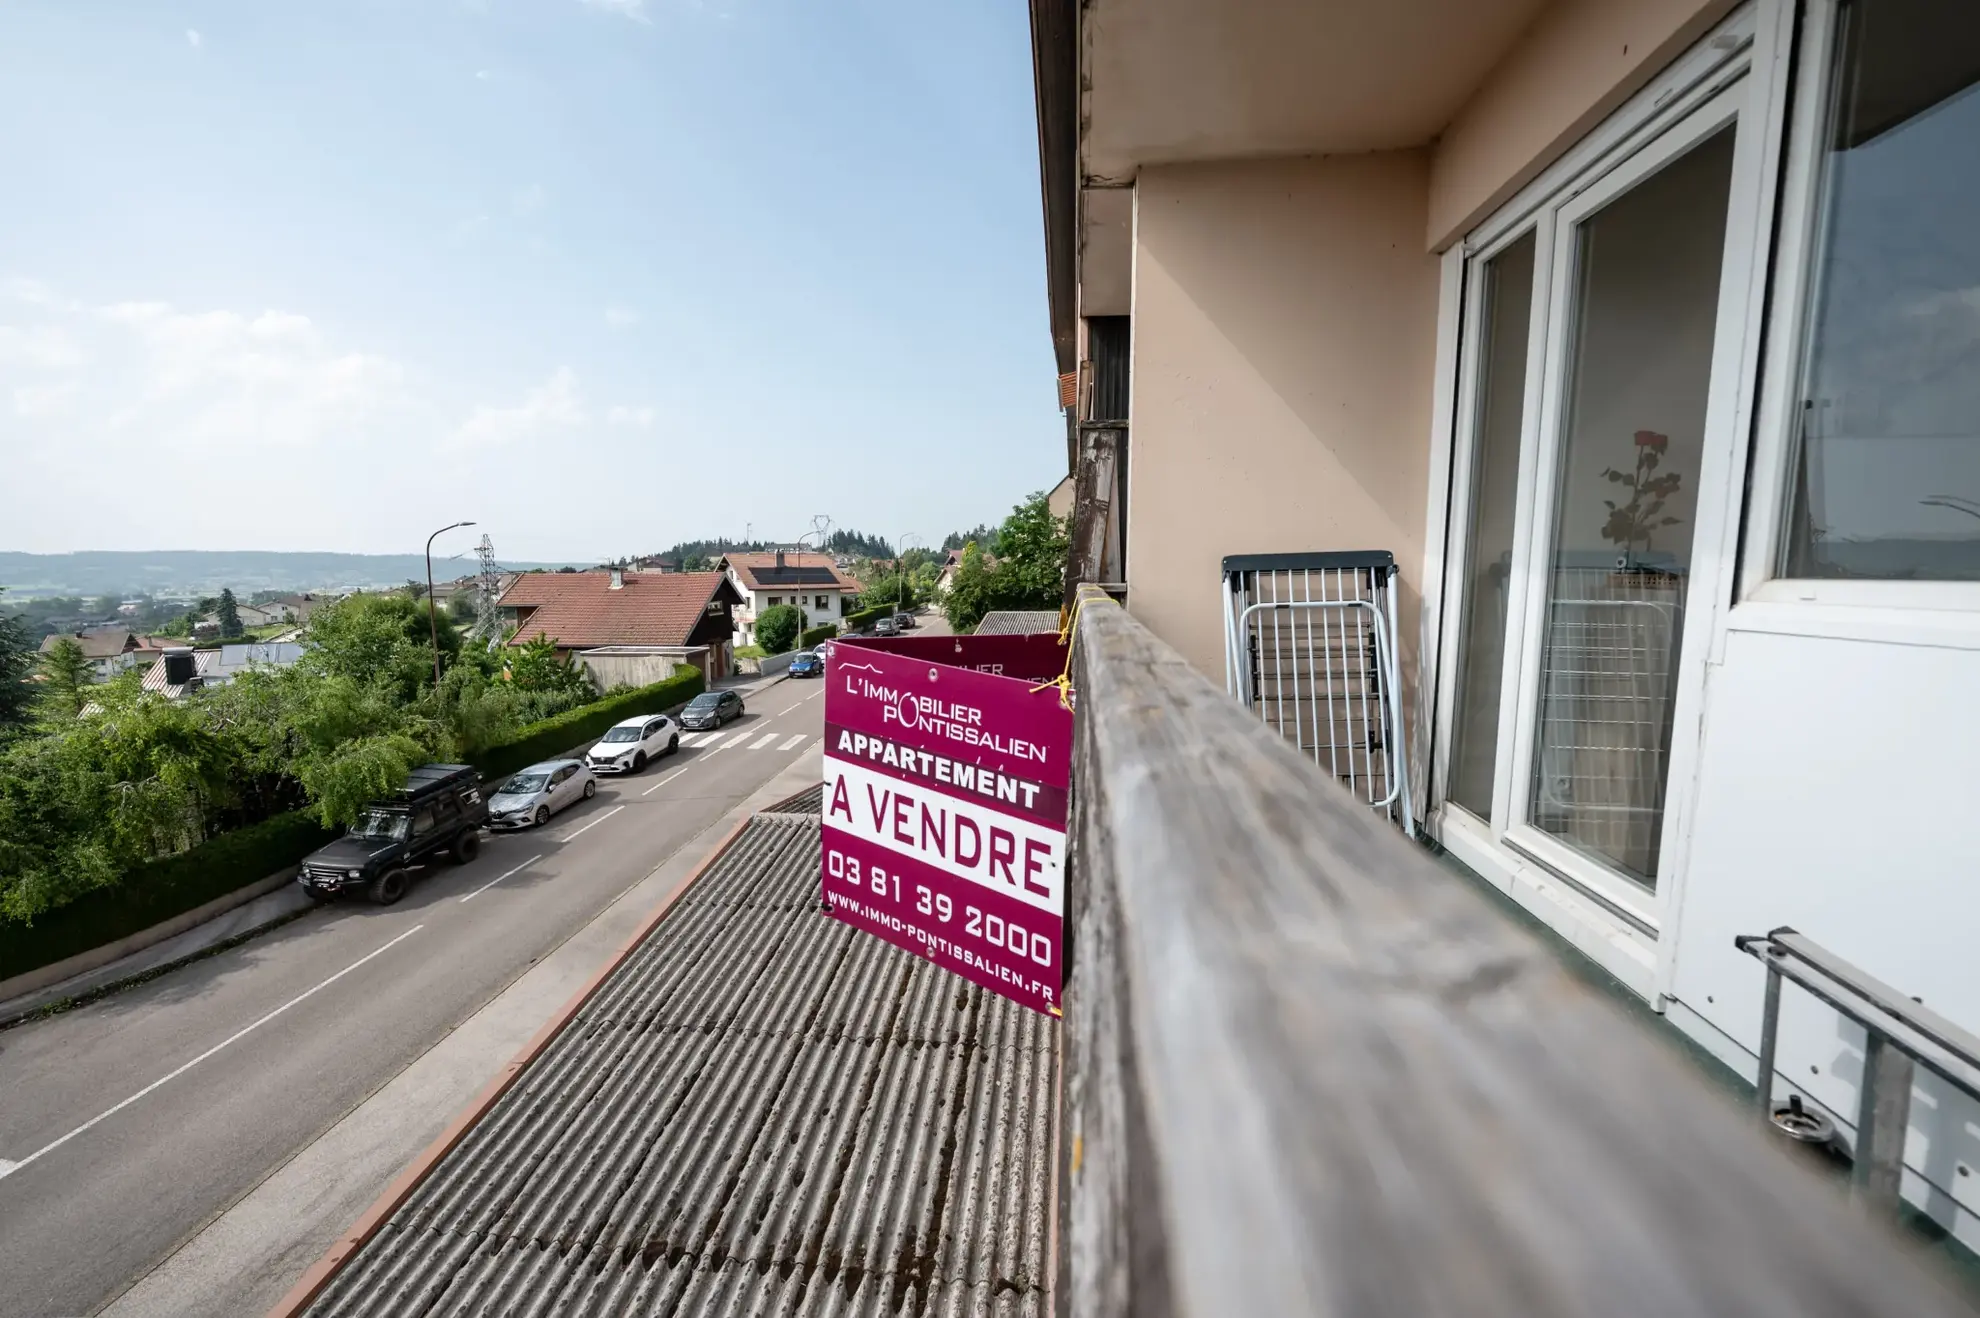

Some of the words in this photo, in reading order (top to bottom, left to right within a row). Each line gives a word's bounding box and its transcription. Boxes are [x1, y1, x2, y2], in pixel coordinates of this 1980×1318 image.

[846, 675, 982, 727] L'IMMOBILIER
[883, 692, 1047, 763] PONTISSALIEN
[838, 730, 1040, 809] APPARTEMENT
[830, 774, 853, 823] A
[867, 784, 1051, 899] VENDRE
[828, 850, 861, 885] 03
[871, 866, 900, 902] 81
[916, 885, 953, 923] 39
[965, 905, 1052, 967] 2000
